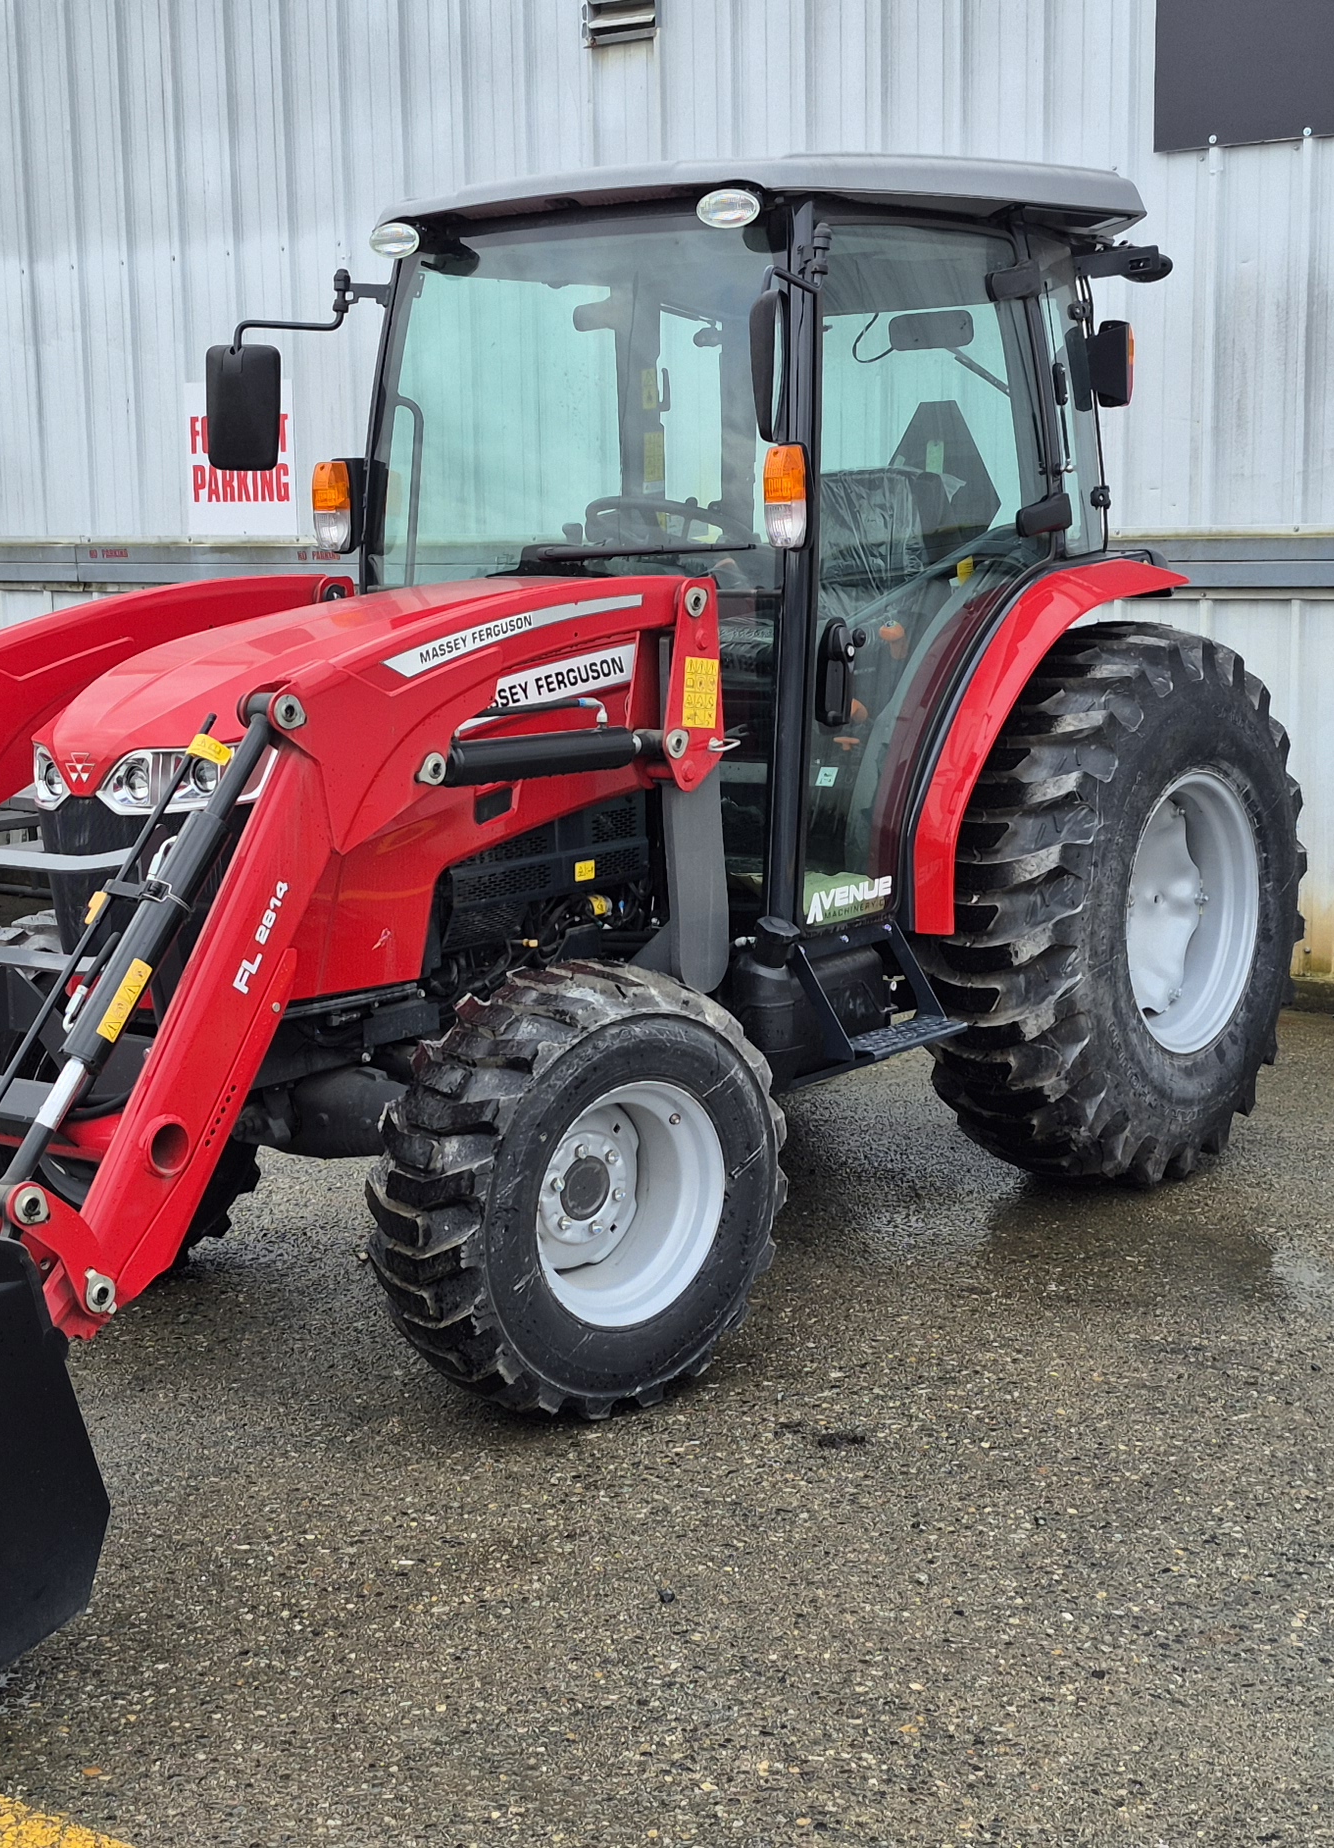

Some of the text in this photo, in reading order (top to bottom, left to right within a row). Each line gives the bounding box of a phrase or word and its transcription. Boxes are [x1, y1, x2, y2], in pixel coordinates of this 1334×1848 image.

[192, 463, 290, 503] PARKING
[419, 614, 533, 664] MASSEY FERGUSON
[535, 656, 625, 696] FERGUSON
[806, 876, 892, 925] AVENUE
[824, 902, 876, 919] MACHINERY
[232, 881, 289, 994] FL 2814
